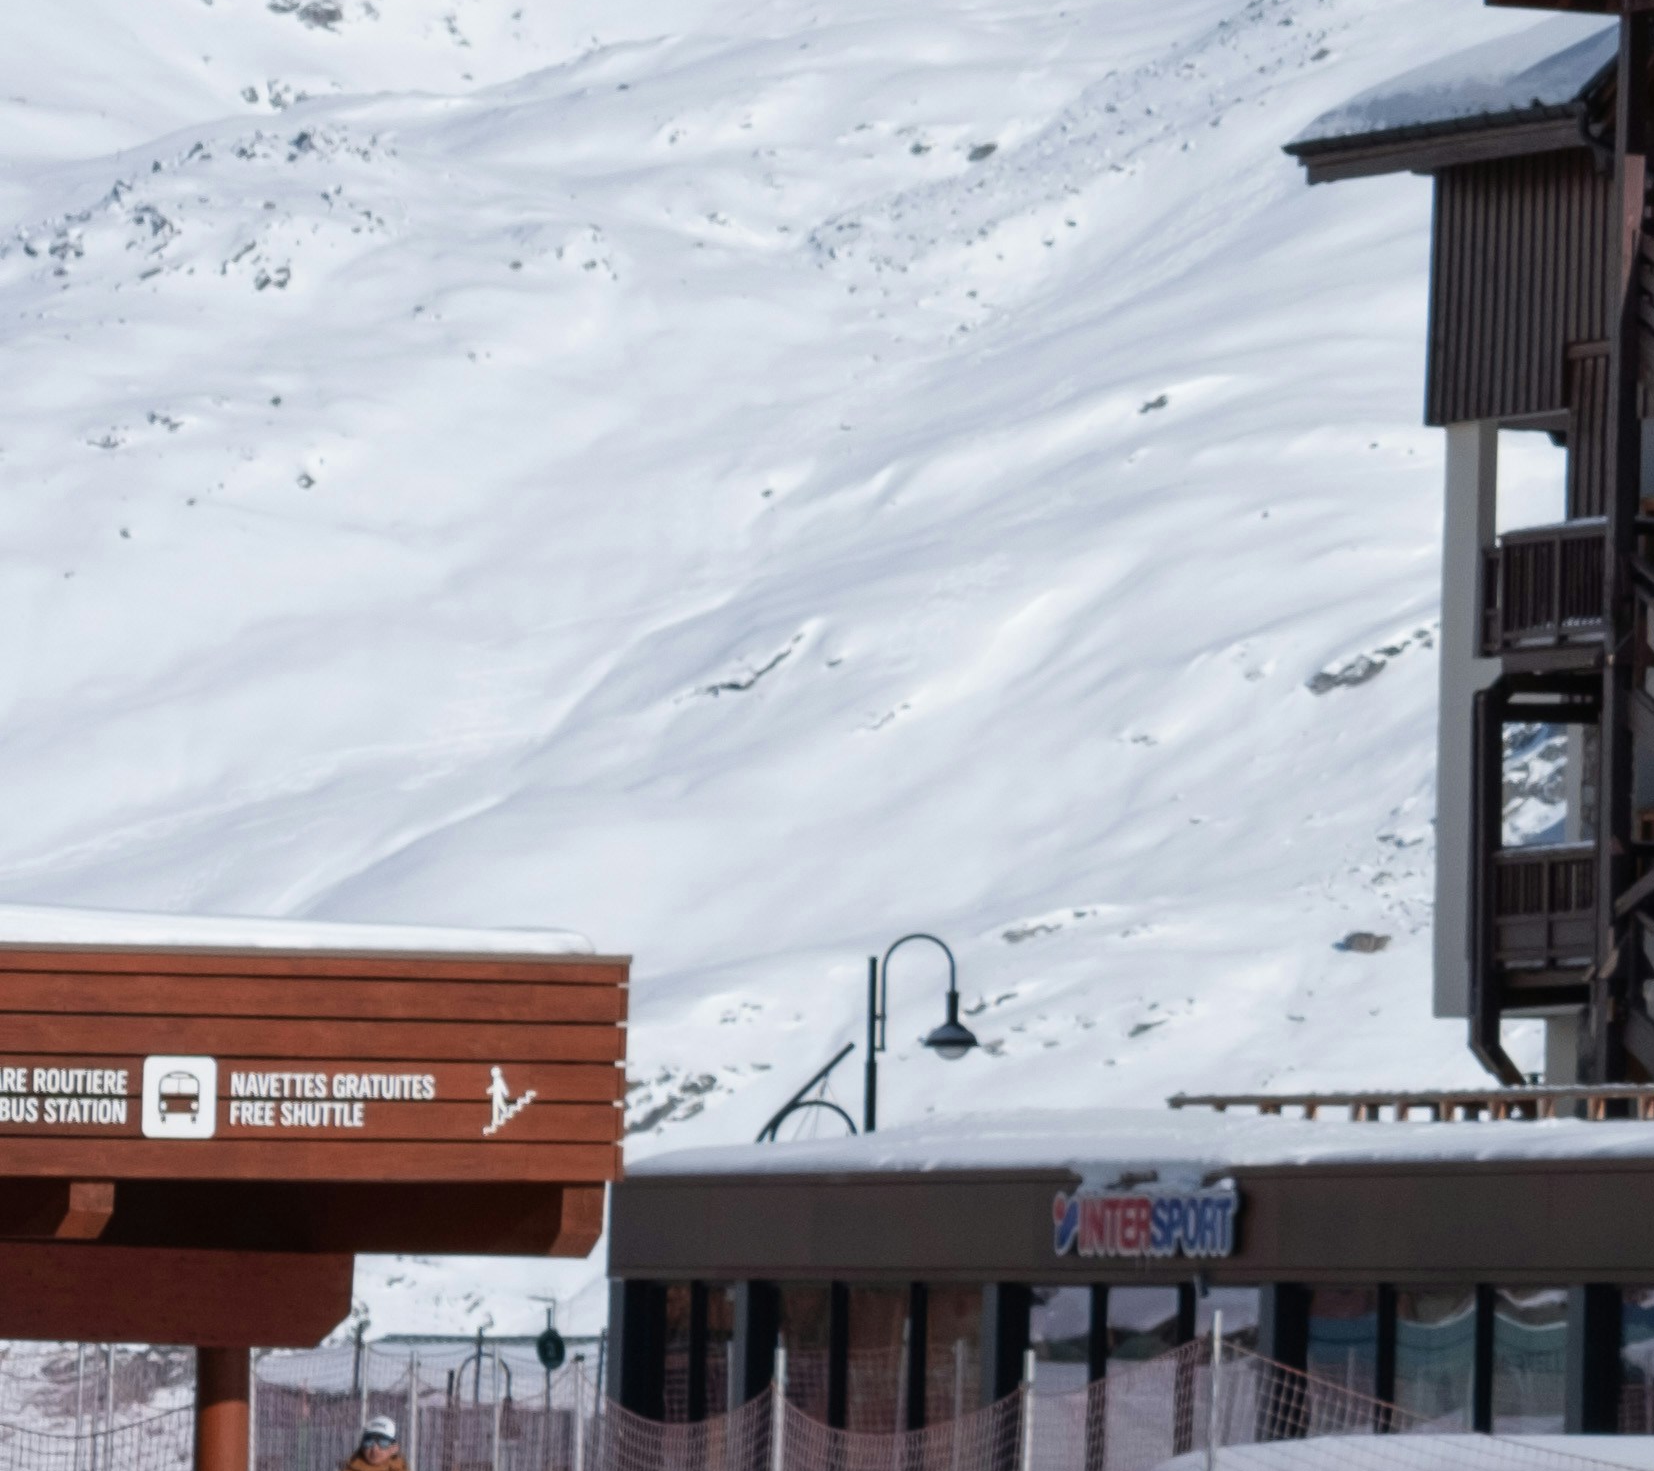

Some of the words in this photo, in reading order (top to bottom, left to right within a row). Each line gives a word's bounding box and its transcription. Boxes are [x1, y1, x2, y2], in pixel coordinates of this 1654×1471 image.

[33, 1067, 129, 1096] ROUTIERE
[230, 1072, 328, 1099] NAVETTES
[332, 1073, 436, 1101] GRATUITES
[0, 1097, 39, 1123] BUS
[44, 1097, 128, 1125] STATION
[229, 1101, 275, 1127] FREE
[280, 1101, 365, 1128] SHUTTLE
[1078, 1195, 1232, 1256] INTERSPORT
